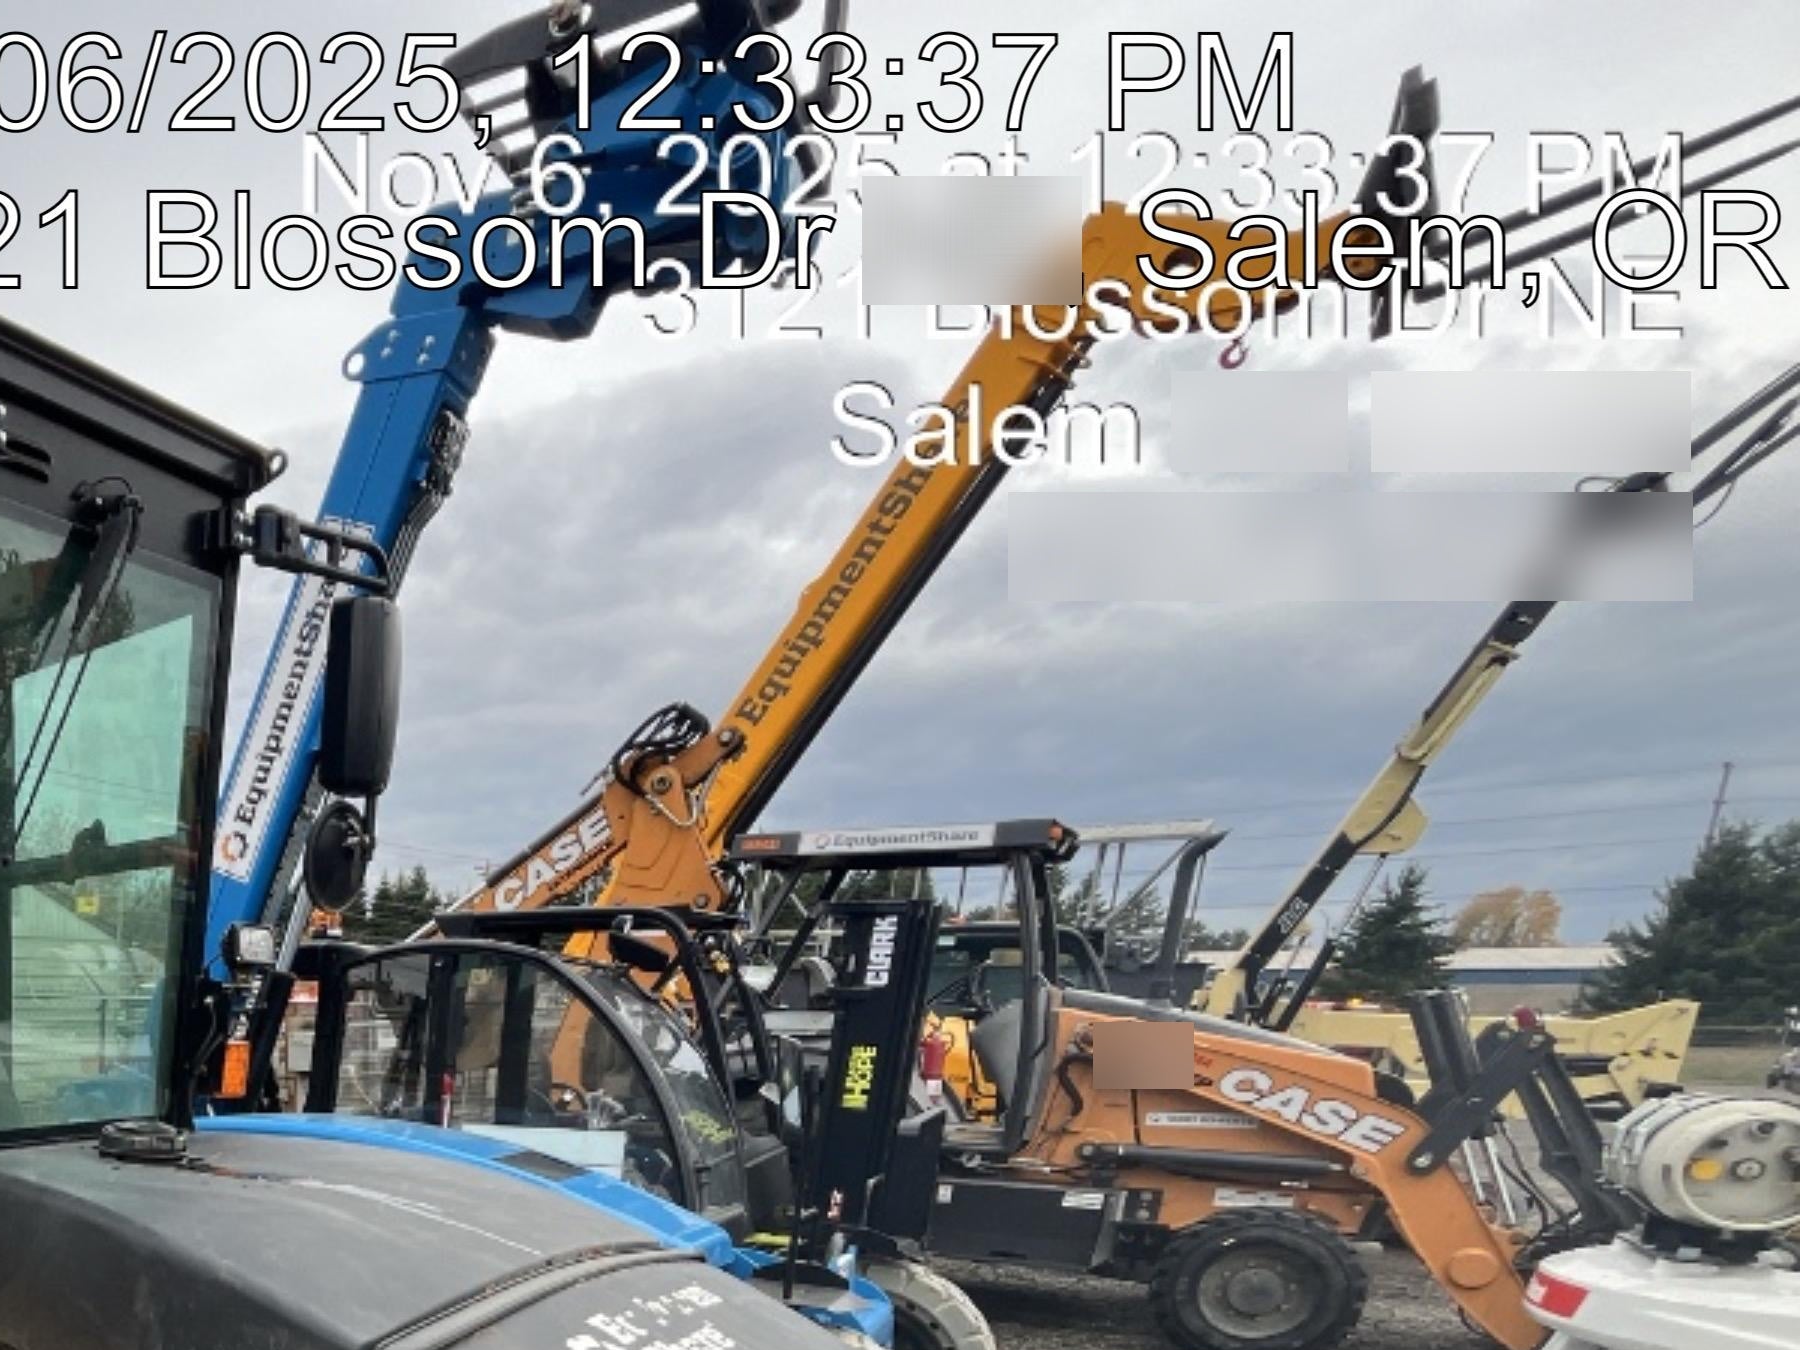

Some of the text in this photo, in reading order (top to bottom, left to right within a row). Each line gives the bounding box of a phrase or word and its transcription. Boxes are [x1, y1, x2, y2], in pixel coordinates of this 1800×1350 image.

[735, 398, 972, 726] EquipmentSh
[234, 547, 350, 828] EquipmentSha
[494, 806, 613, 912] CASE
[864, 914, 899, 987] CLARK
[1218, 1066, 1406, 1153] CASE
